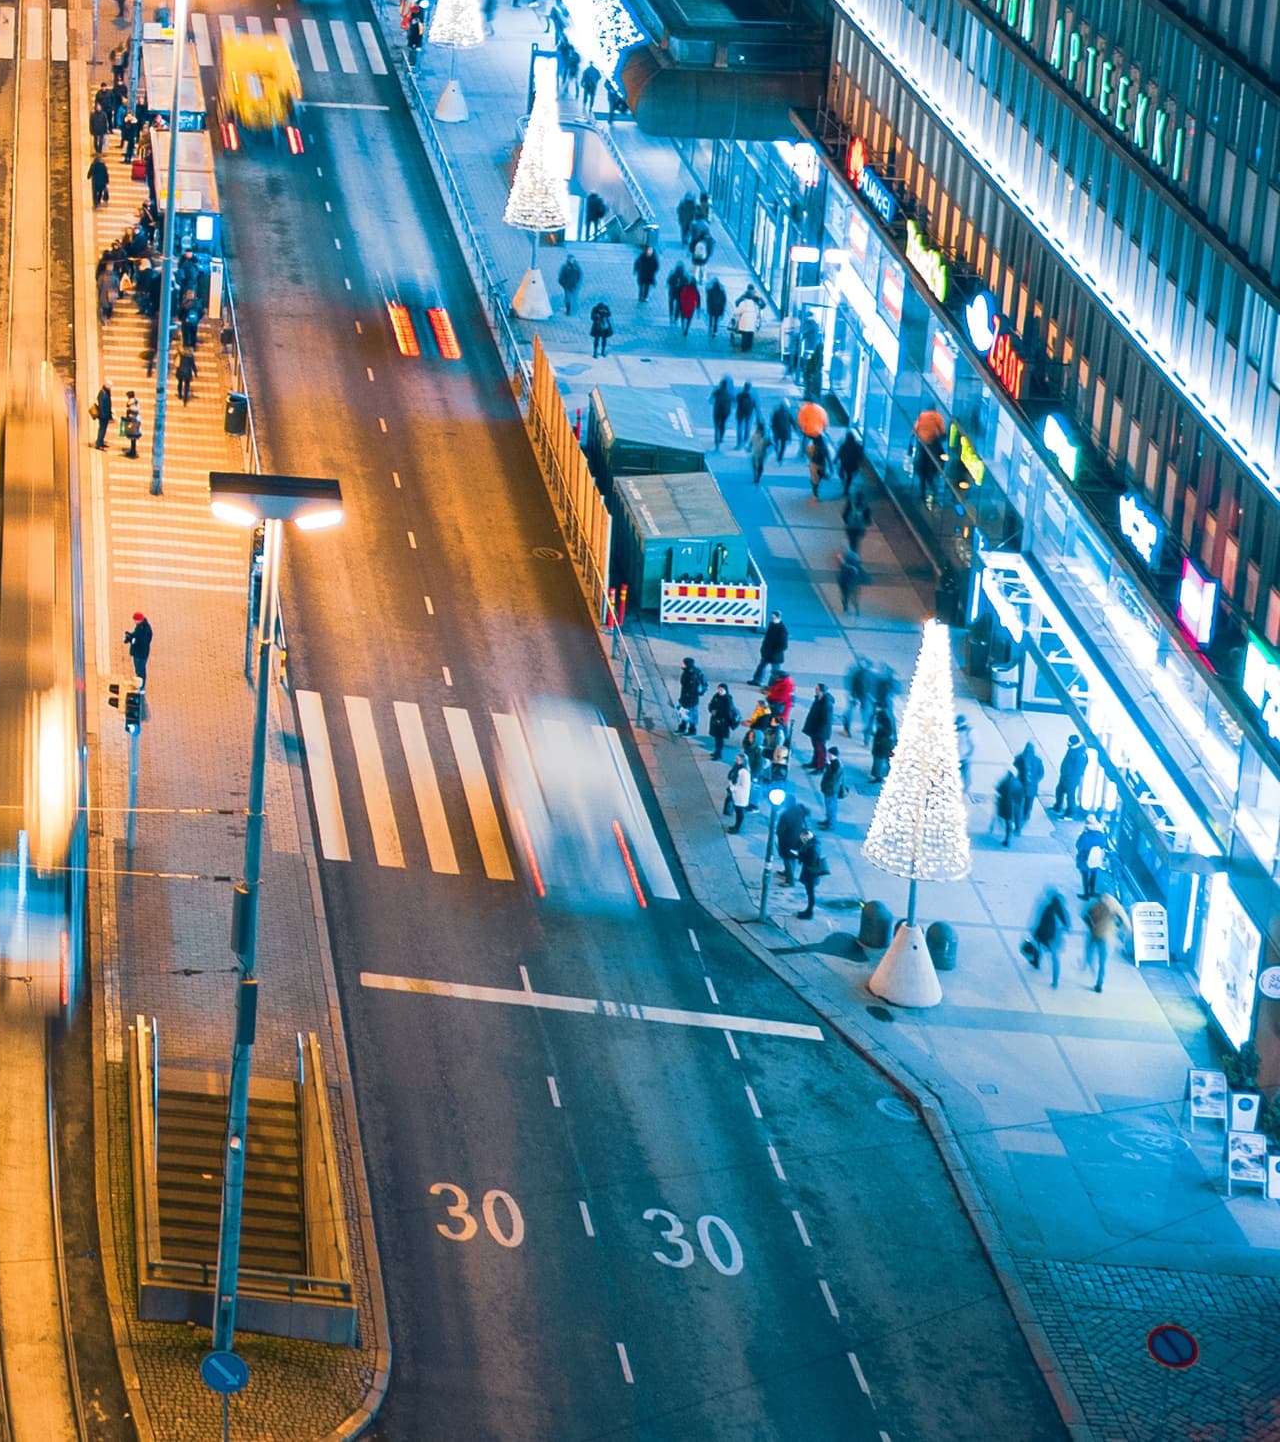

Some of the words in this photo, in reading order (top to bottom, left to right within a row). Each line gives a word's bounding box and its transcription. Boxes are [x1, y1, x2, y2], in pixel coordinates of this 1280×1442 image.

[1050, 18, 1184, 181] APTEEKKI
[858, 167, 891, 221] HUAWEI
[988, 314, 1026, 401] Zetor
[429, 1182, 525, 1248] 30
[642, 1208, 744, 1276] 30
